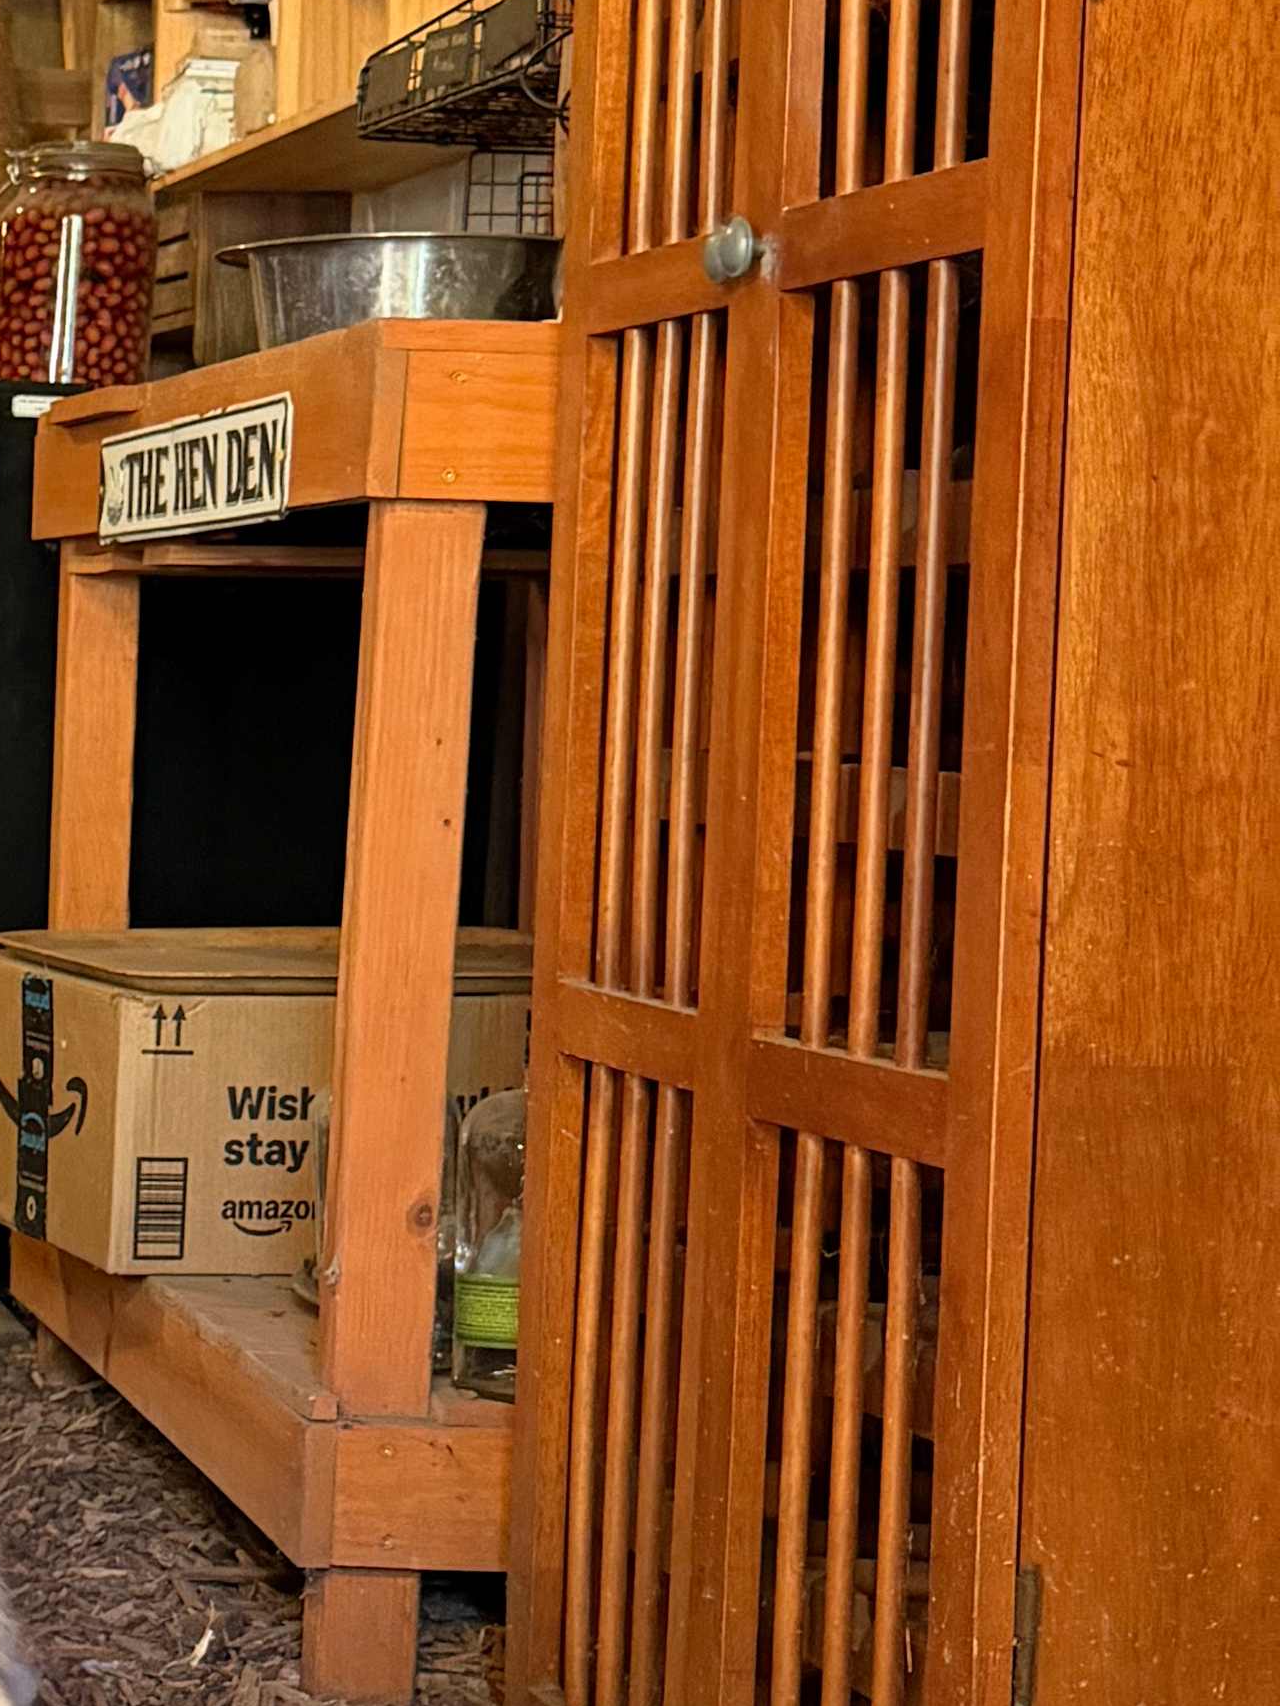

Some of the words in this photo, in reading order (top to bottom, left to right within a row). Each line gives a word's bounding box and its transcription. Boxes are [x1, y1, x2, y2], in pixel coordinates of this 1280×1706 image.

[120, 445, 169, 522] THE
[173, 434, 218, 515] HEN
[225, 419, 279, 507] DEN
[223, 1132, 310, 1174] stay
